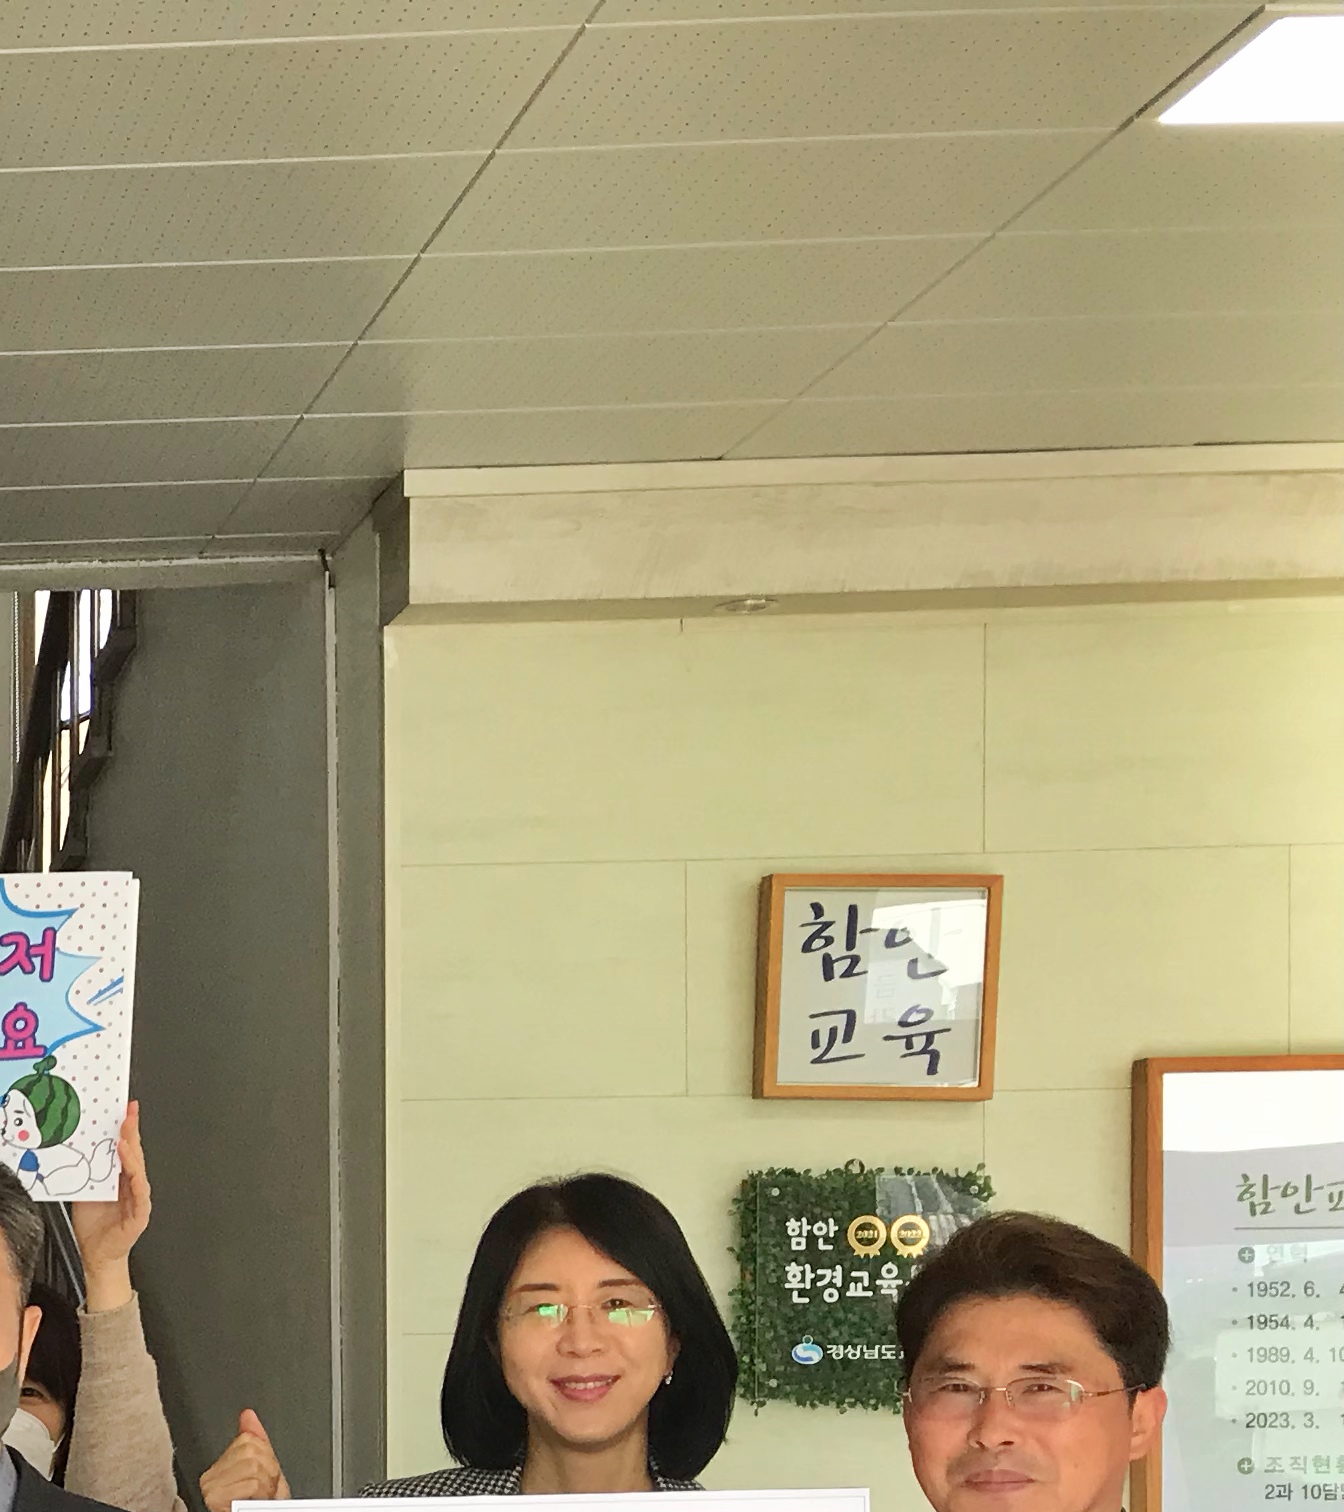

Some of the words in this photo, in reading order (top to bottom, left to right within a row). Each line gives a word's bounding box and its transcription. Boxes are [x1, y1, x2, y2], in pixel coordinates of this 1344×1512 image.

[809, 1004, 952, 1076] 교육
[785, 1217, 839, 1250] 함안
[1247, 1281, 1296, 1298] 1952.
[1304, 1280, 1320, 1298] 6.
[1247, 1314, 1296, 1331] 1954.
[1304, 1314, 1320, 1331] 4.
[1247, 1347, 1296, 1364] 1989.
[1303, 1346, 1320, 1364] 4.
[1245, 1412, 1296, 1429] 2023.
[1303, 1411, 1320, 1429] 3.
